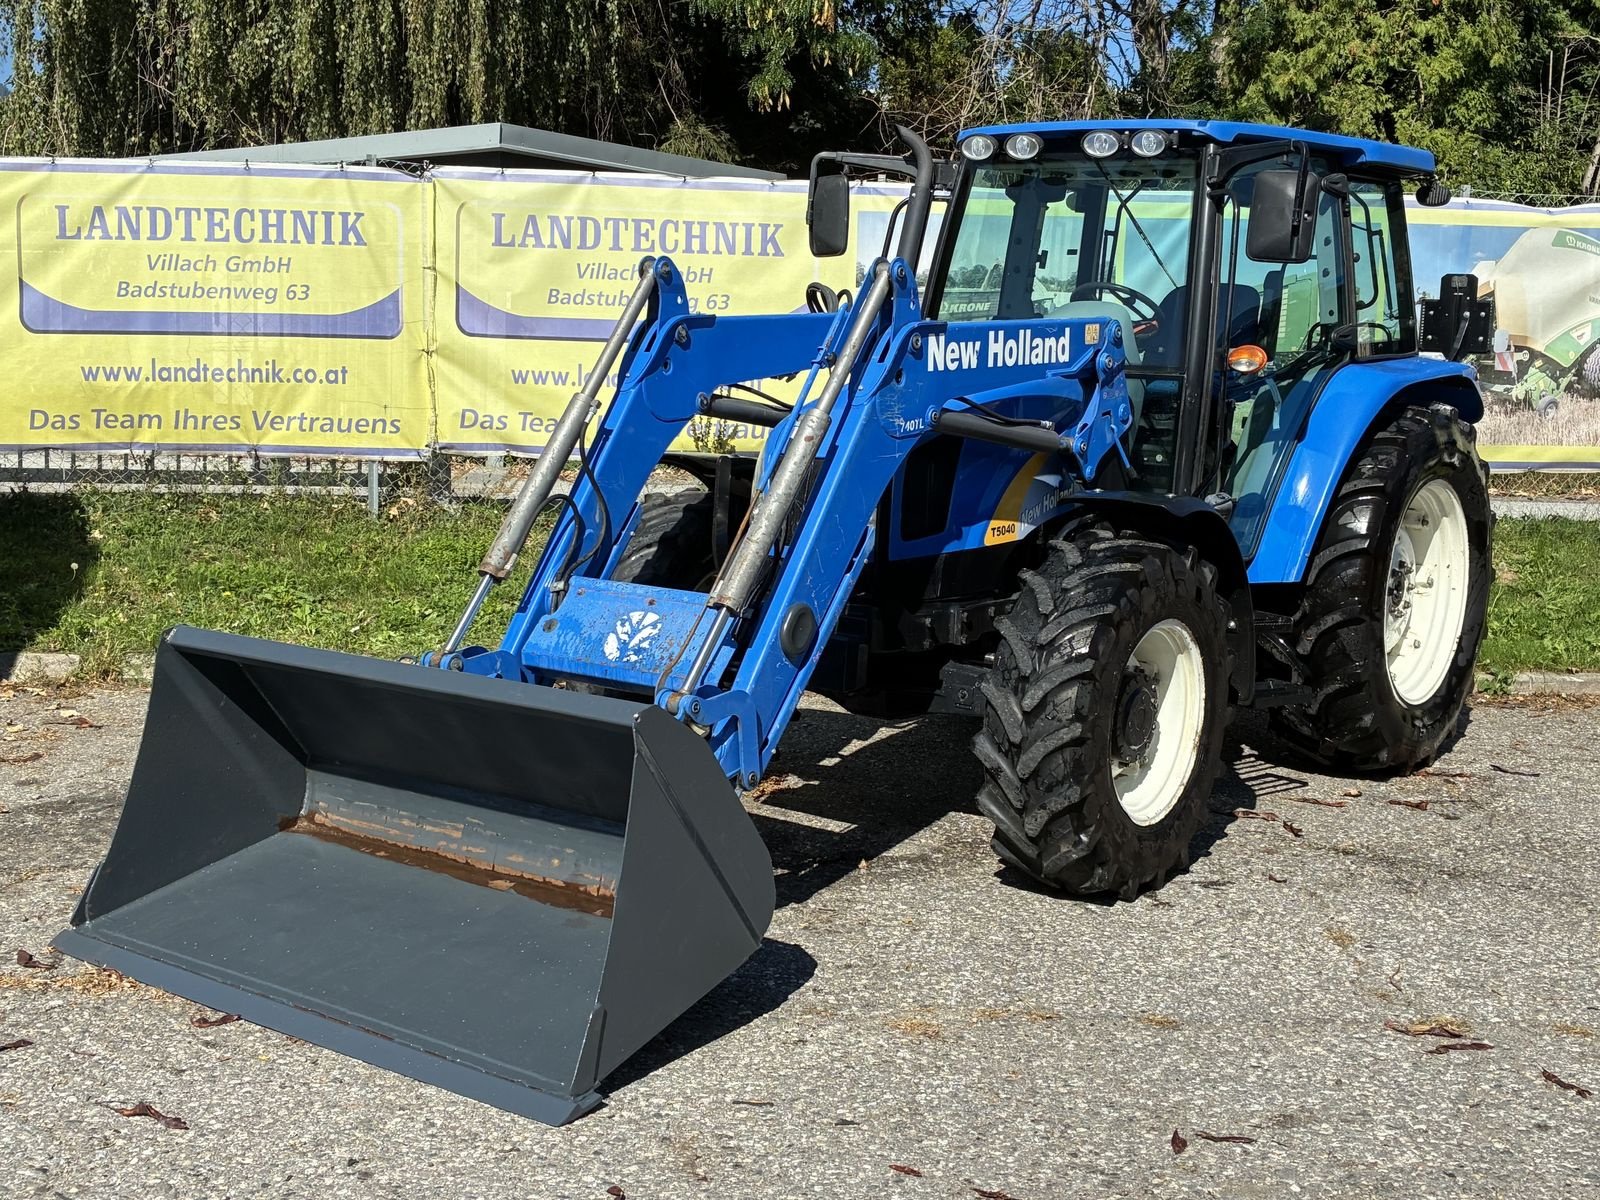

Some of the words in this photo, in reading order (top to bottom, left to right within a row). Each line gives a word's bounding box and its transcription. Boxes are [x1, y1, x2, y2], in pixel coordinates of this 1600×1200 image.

[55, 204, 368, 247] LANDTECHNIK
[491, 212, 785, 258] LANDTECHNIK
[146, 253, 217, 274] Villach
[225, 255, 292, 274] GmbH
[116, 280, 279, 305] Badstubenweg
[285, 284, 311, 301] 63
[547, 288, 699, 313] Badstubg
[706, 293, 731, 311] 63
[949, 302, 991, 314] KRONE
[927, 331, 981, 372] New
[987, 327, 1071, 368] Holland
[80, 358, 348, 385] www.landtechnik.co.at
[29, 408, 81, 431] Das
[91, 408, 163, 431] Team
[174, 409, 241, 432] Ihres
[252, 410, 402, 435] Vertrauens
[459, 408, 508, 431] Das
[518, 411, 560, 433] Tea
[1020, 502, 1042, 532] New
[1043, 482, 1075, 513] Holland
[990, 522, 1016, 538] T5040
